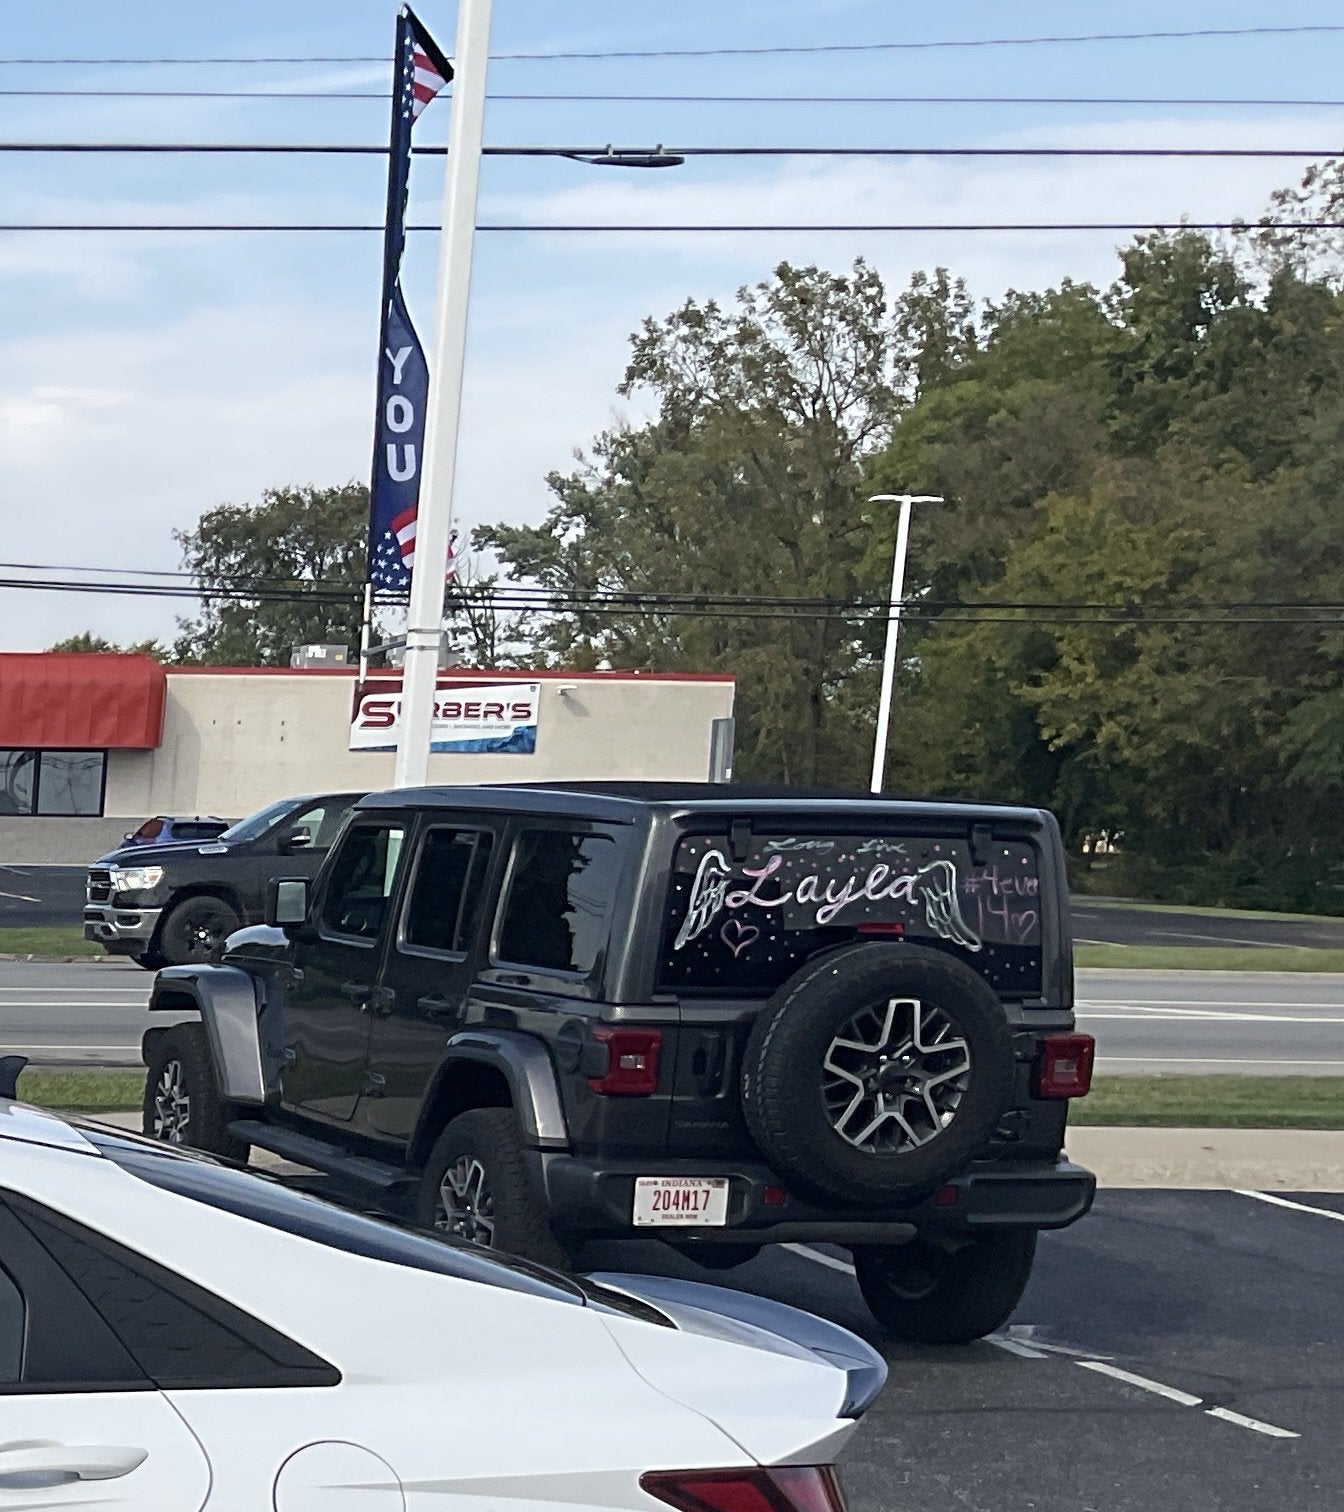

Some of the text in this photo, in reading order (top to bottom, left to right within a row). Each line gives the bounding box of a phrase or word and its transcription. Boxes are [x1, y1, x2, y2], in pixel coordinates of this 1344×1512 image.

[385, 345, 417, 482] YOU
[359, 701, 532, 729] SBER'S
[725, 855, 920, 924] Layla
[661, 1179, 703, 1187] INDIANA
[652, 1189, 711, 1211] 204M17
